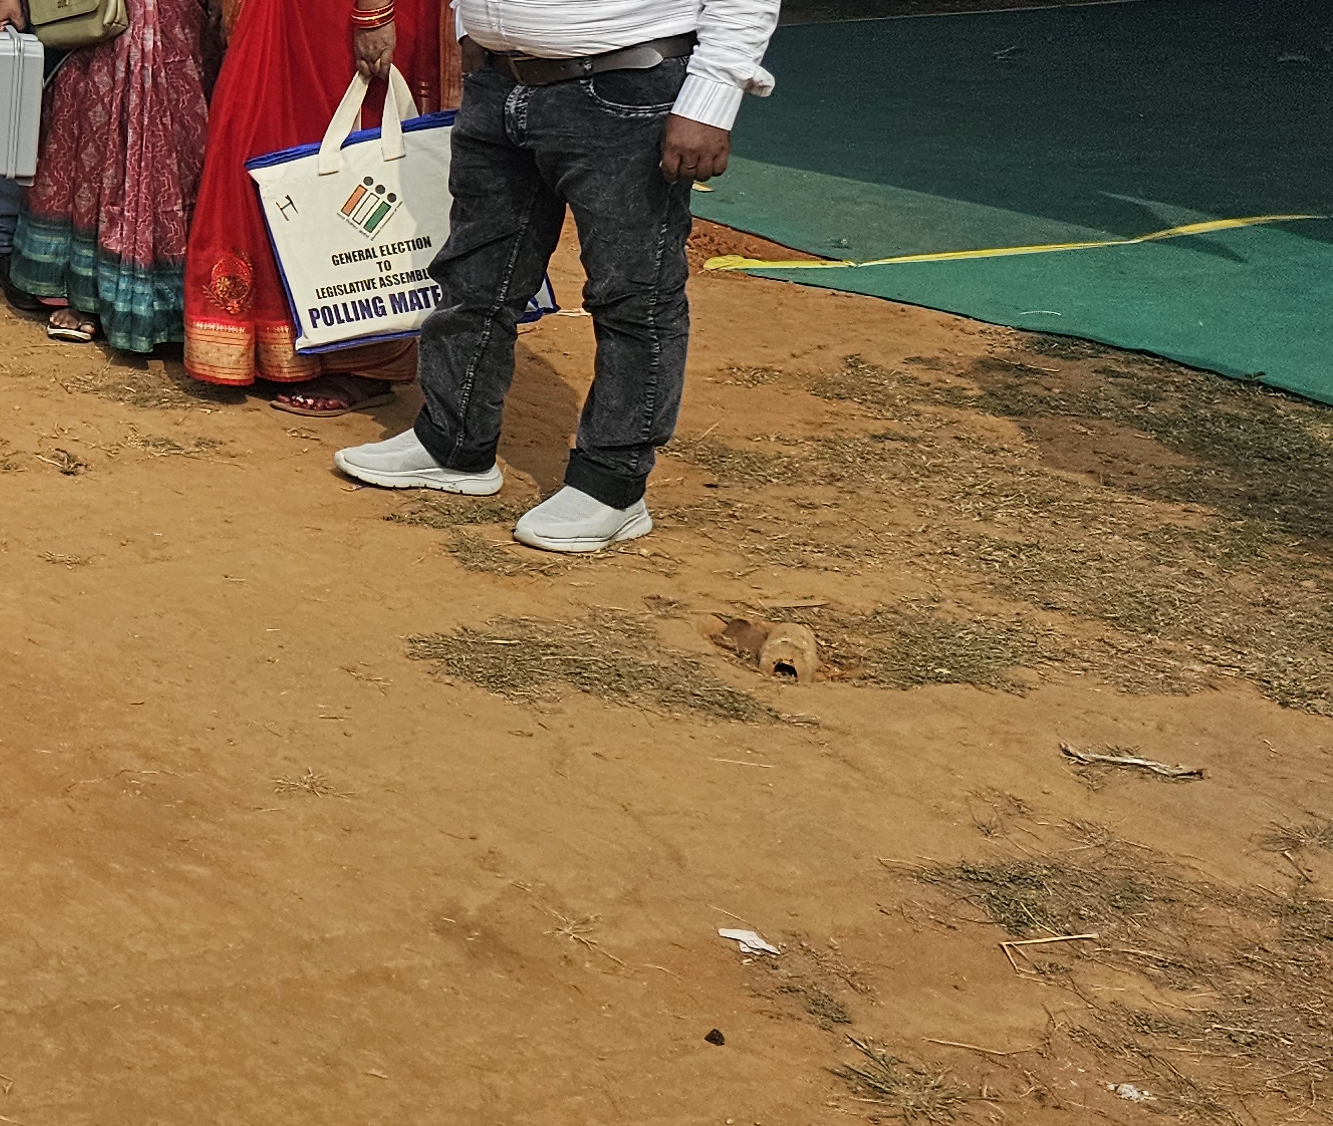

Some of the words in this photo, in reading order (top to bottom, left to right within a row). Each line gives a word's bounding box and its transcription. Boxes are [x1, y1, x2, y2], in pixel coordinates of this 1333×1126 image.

[331, 247, 379, 267] GENERAL
[378, 236, 433, 257] ELECTION
[376, 260, 392, 273] TO
[315, 278, 378, 300] LEGISLATIVE
[379, 268, 431, 289] ASSEMBL
[308, 296, 387, 329] POLLING
